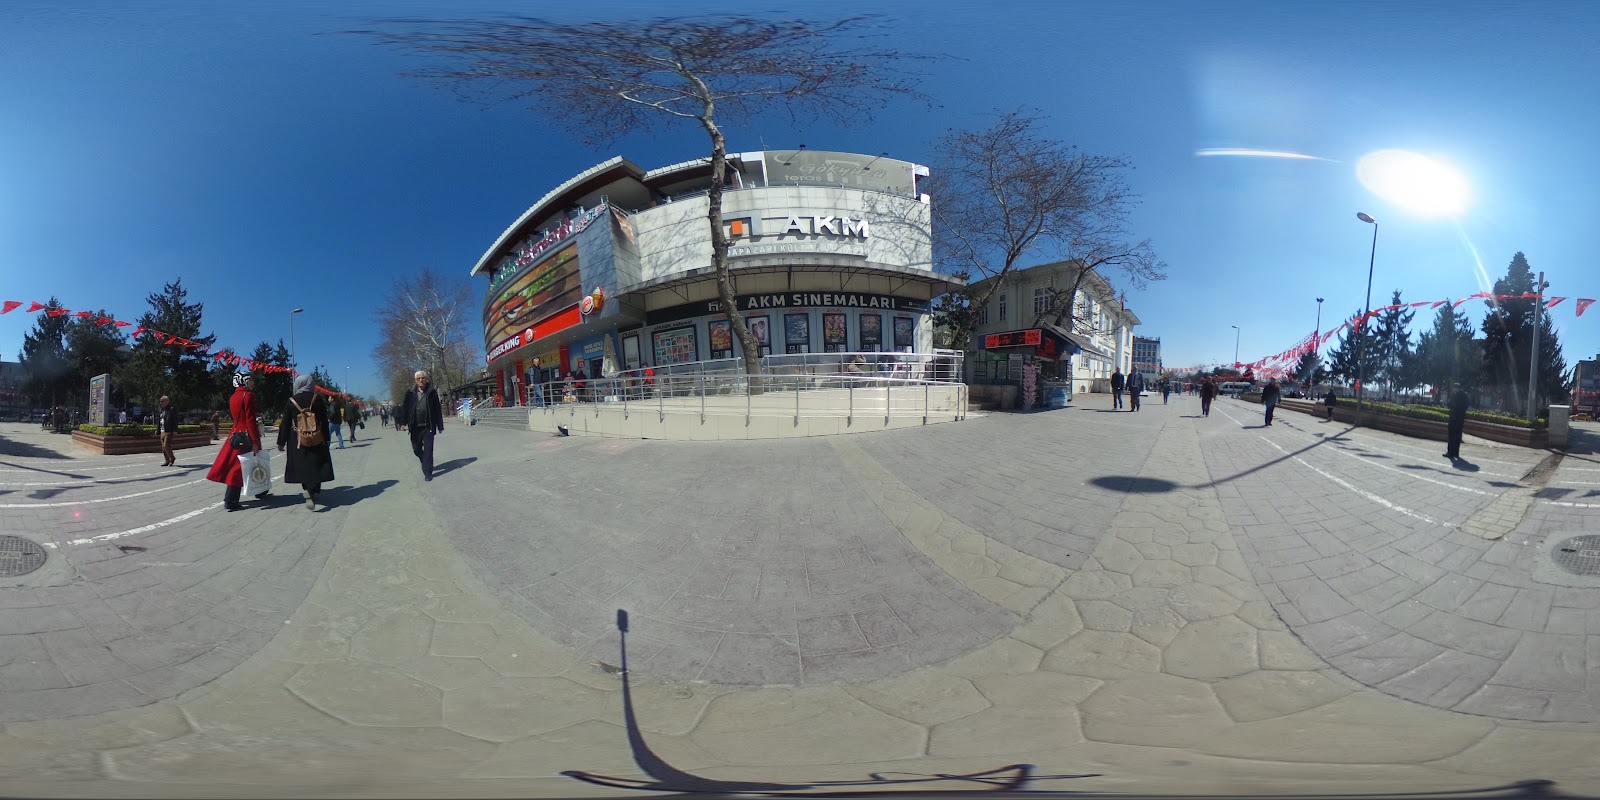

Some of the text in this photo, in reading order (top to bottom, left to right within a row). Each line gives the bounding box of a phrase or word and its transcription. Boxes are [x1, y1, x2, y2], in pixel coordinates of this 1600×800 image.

[784, 174, 822, 182] teras
[799, 163, 887, 179] Gökyüzü
[785, 215, 869, 238] AKM
[728, 245, 777, 256] APAZARI
[748, 294, 786, 309] AKM
[504, 335, 520, 351] KING
